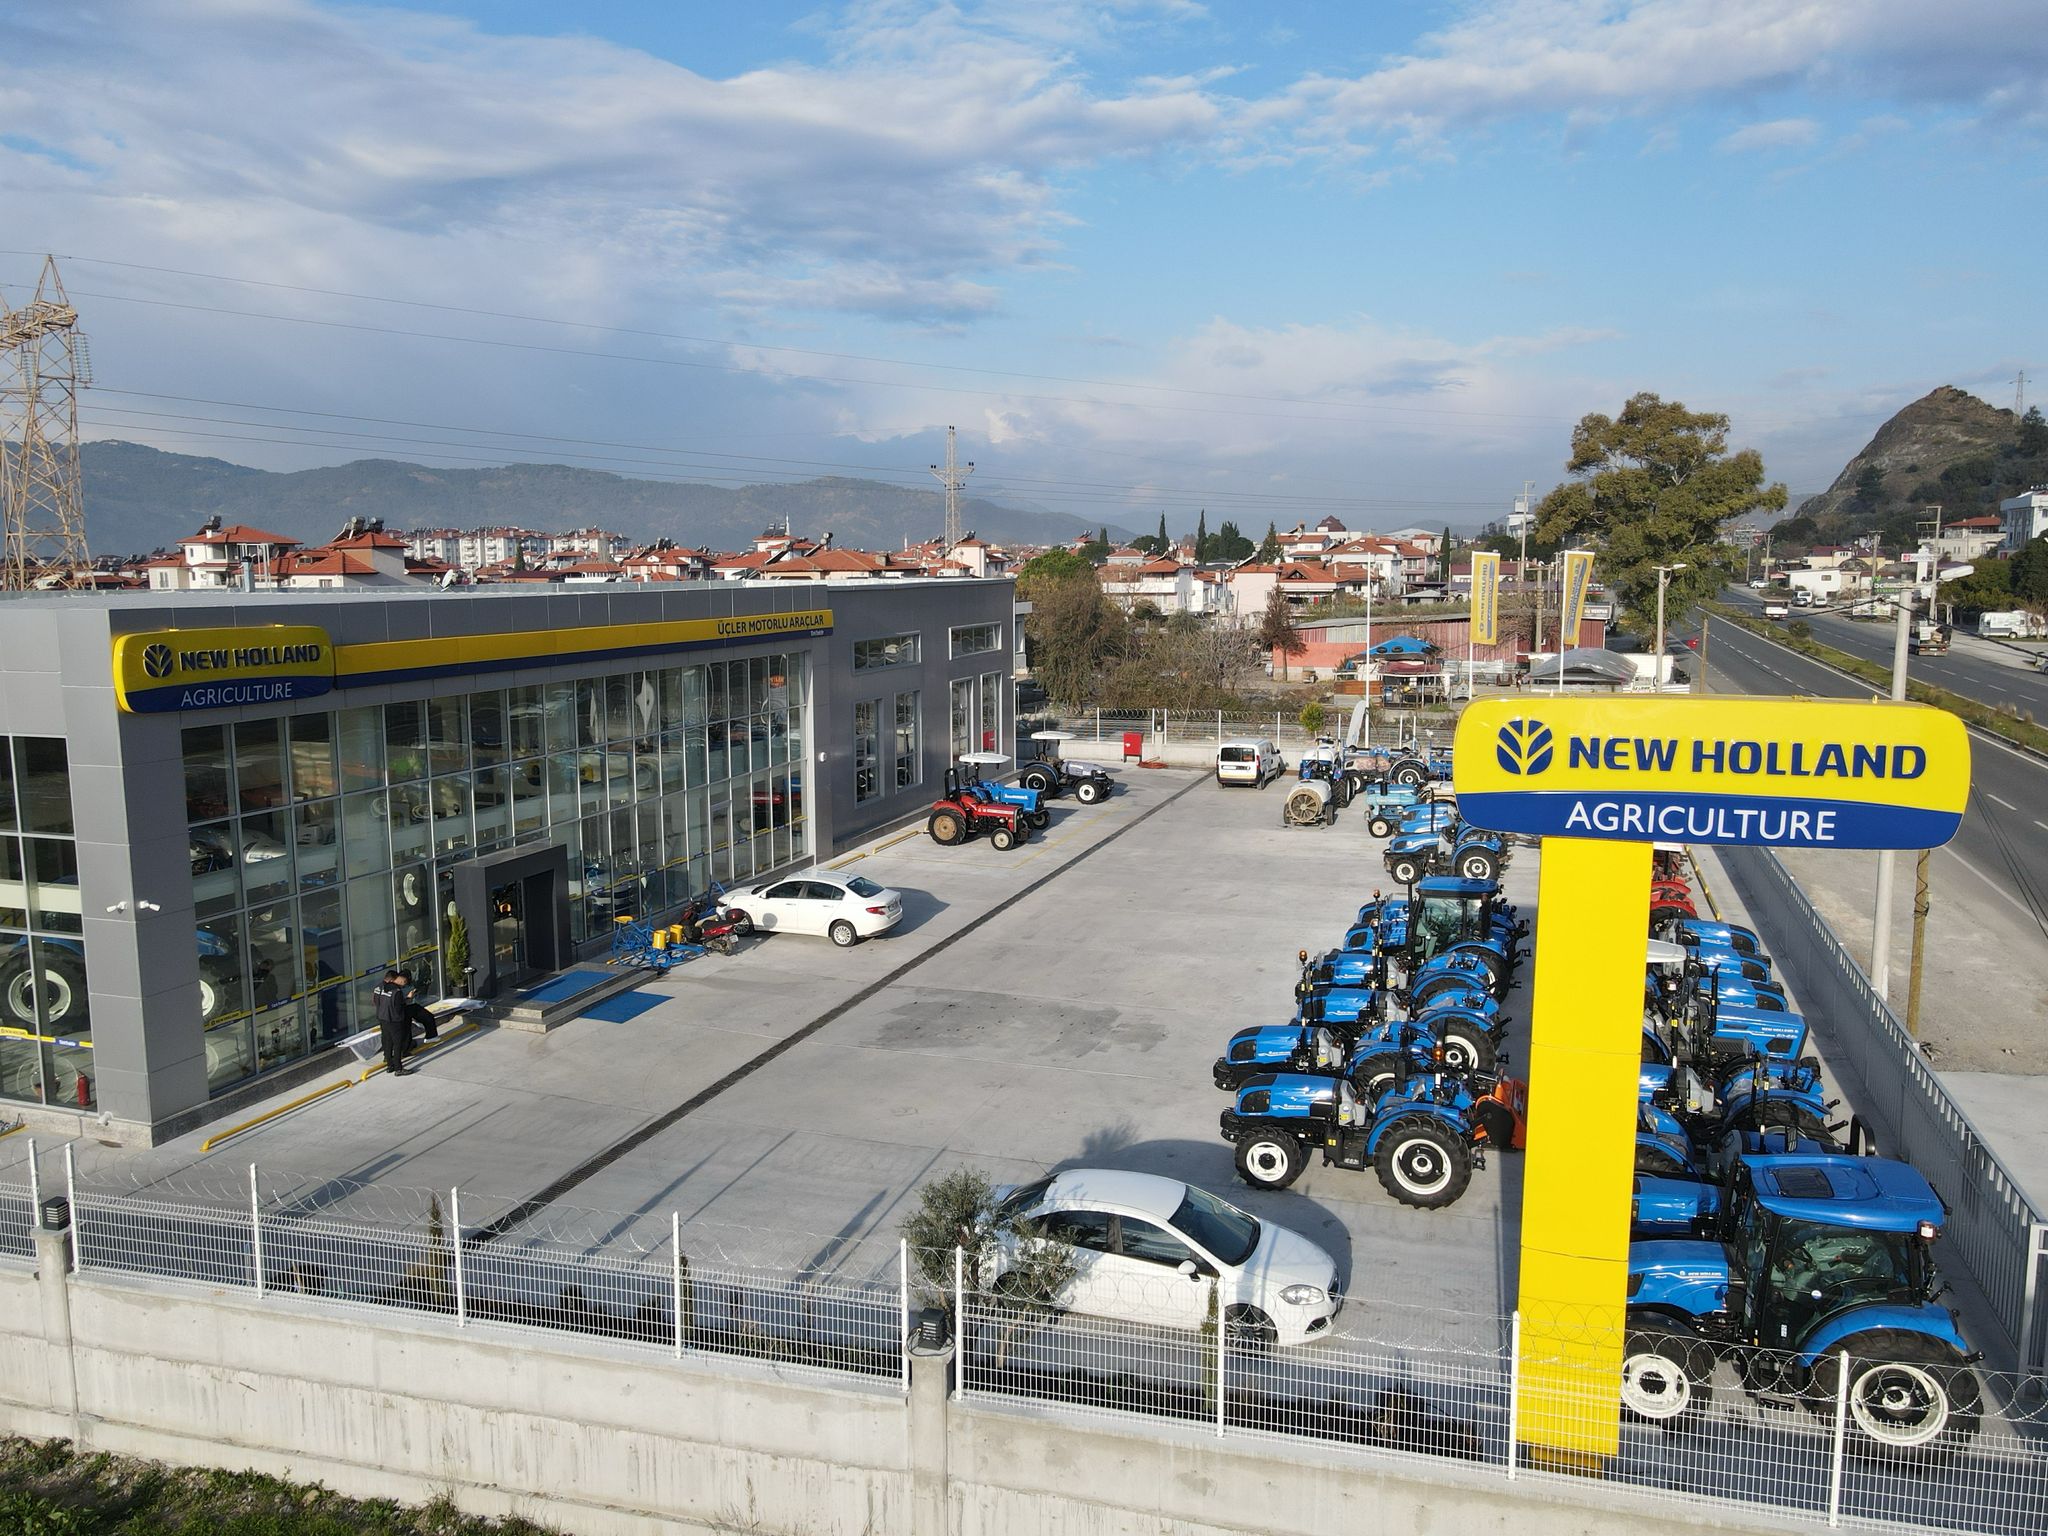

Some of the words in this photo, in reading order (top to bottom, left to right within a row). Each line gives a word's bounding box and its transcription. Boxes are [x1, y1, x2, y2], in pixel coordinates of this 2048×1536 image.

[717, 620, 747, 637] ÜÇLER
[748, 617, 788, 633] MOTORLU
[789, 615, 824, 629] ARAÇLAR
[179, 648, 228, 672] NEW
[232, 644, 320, 667] HOLLAND
[180, 682, 293, 707] AGRICULTURE
[1569, 737, 1678, 772] NEW
[1692, 740, 1927, 779] HOLLAND
[1564, 801, 1837, 841] AGRICULTURE
